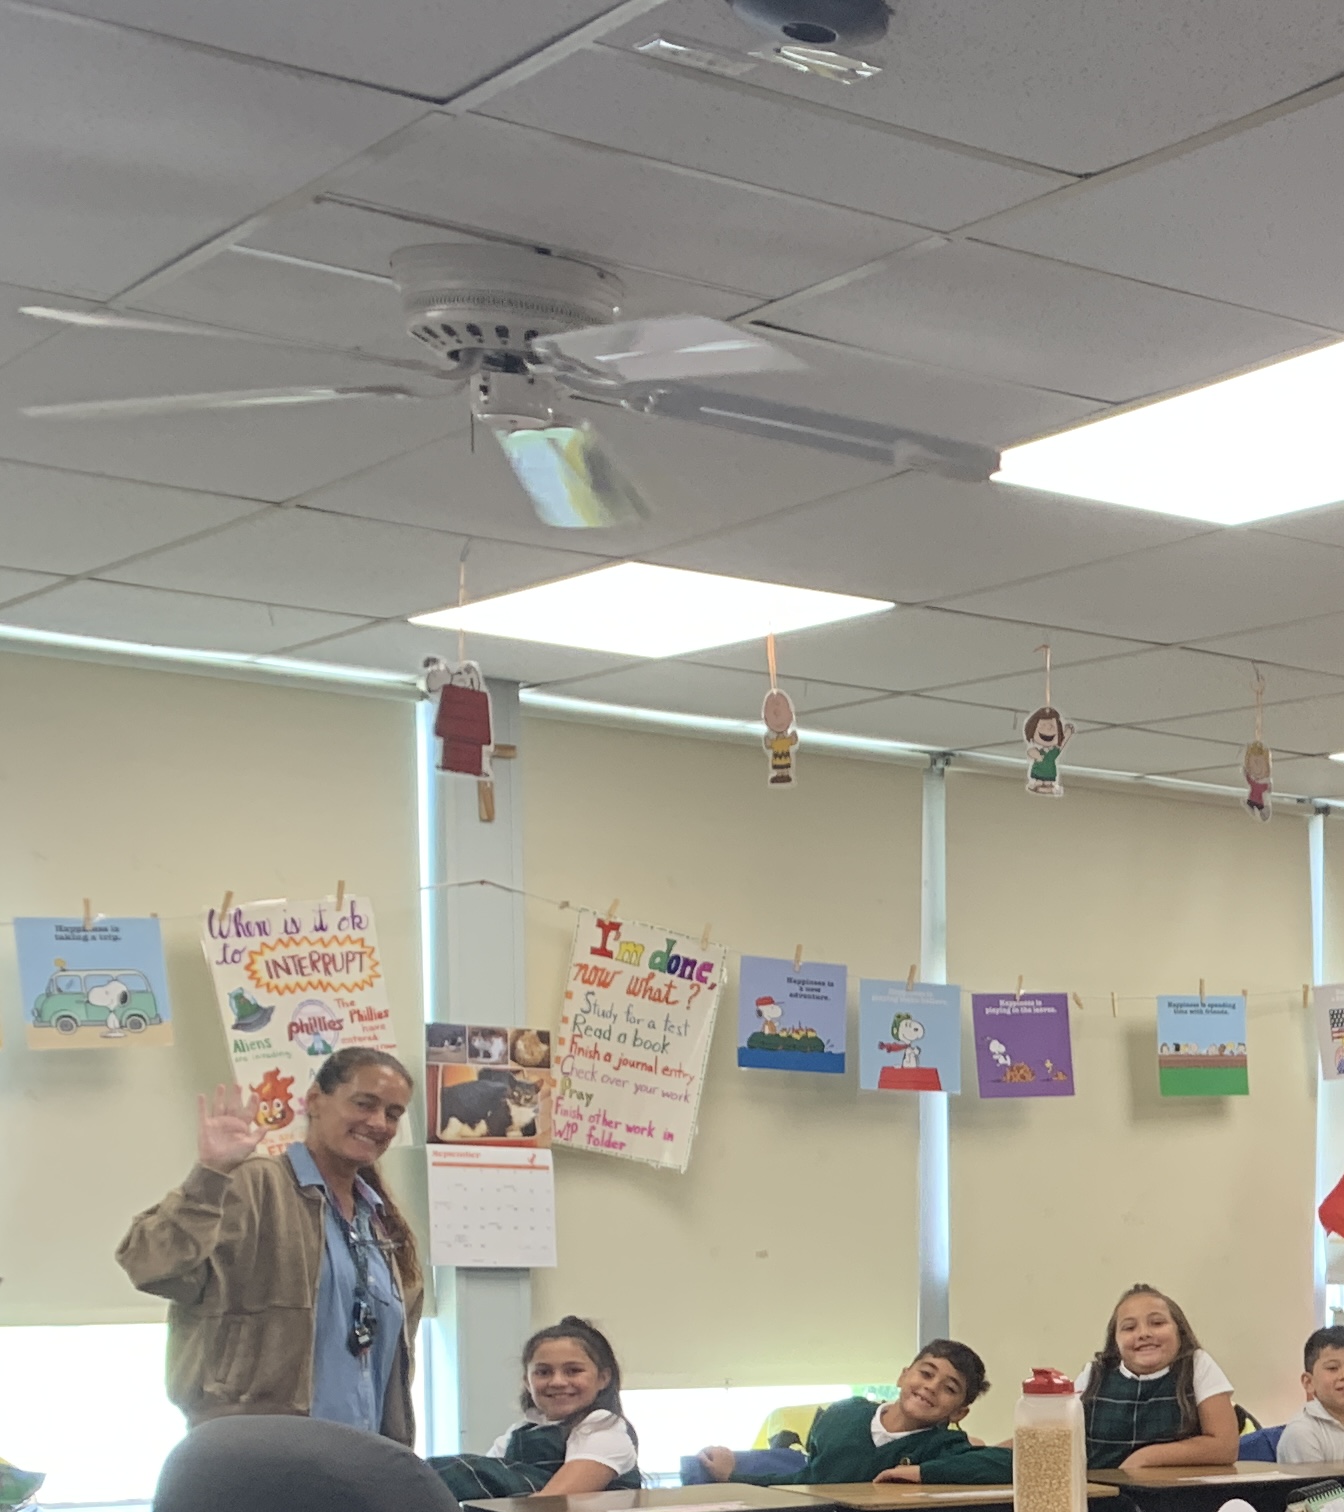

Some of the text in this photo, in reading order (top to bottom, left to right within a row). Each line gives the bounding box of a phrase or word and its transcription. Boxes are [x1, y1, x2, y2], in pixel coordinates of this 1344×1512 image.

[208, 900, 368, 939] When is it ok
[216, 943, 246, 965] to
[265, 950, 366, 979] INTERRUPT
[590, 918, 717, 990] I'm done,
[334, 998, 355, 1009] The
[573, 963, 701, 1010] now what ?
[349, 1006, 389, 1023] Phillies
[580, 990, 690, 1037] Study for a test
[233, 1037, 271, 1053] Aliens
[572, 1014, 670, 1054] Read a book
[560, 1054, 690, 1104] Check over your work
[569, 1033, 695, 1086] Finish a journal entry
[560, 1075, 594, 1107] Pray
[553, 1120, 627, 1151] WIP folder
[554, 1096, 675, 1142] Finish other work in
